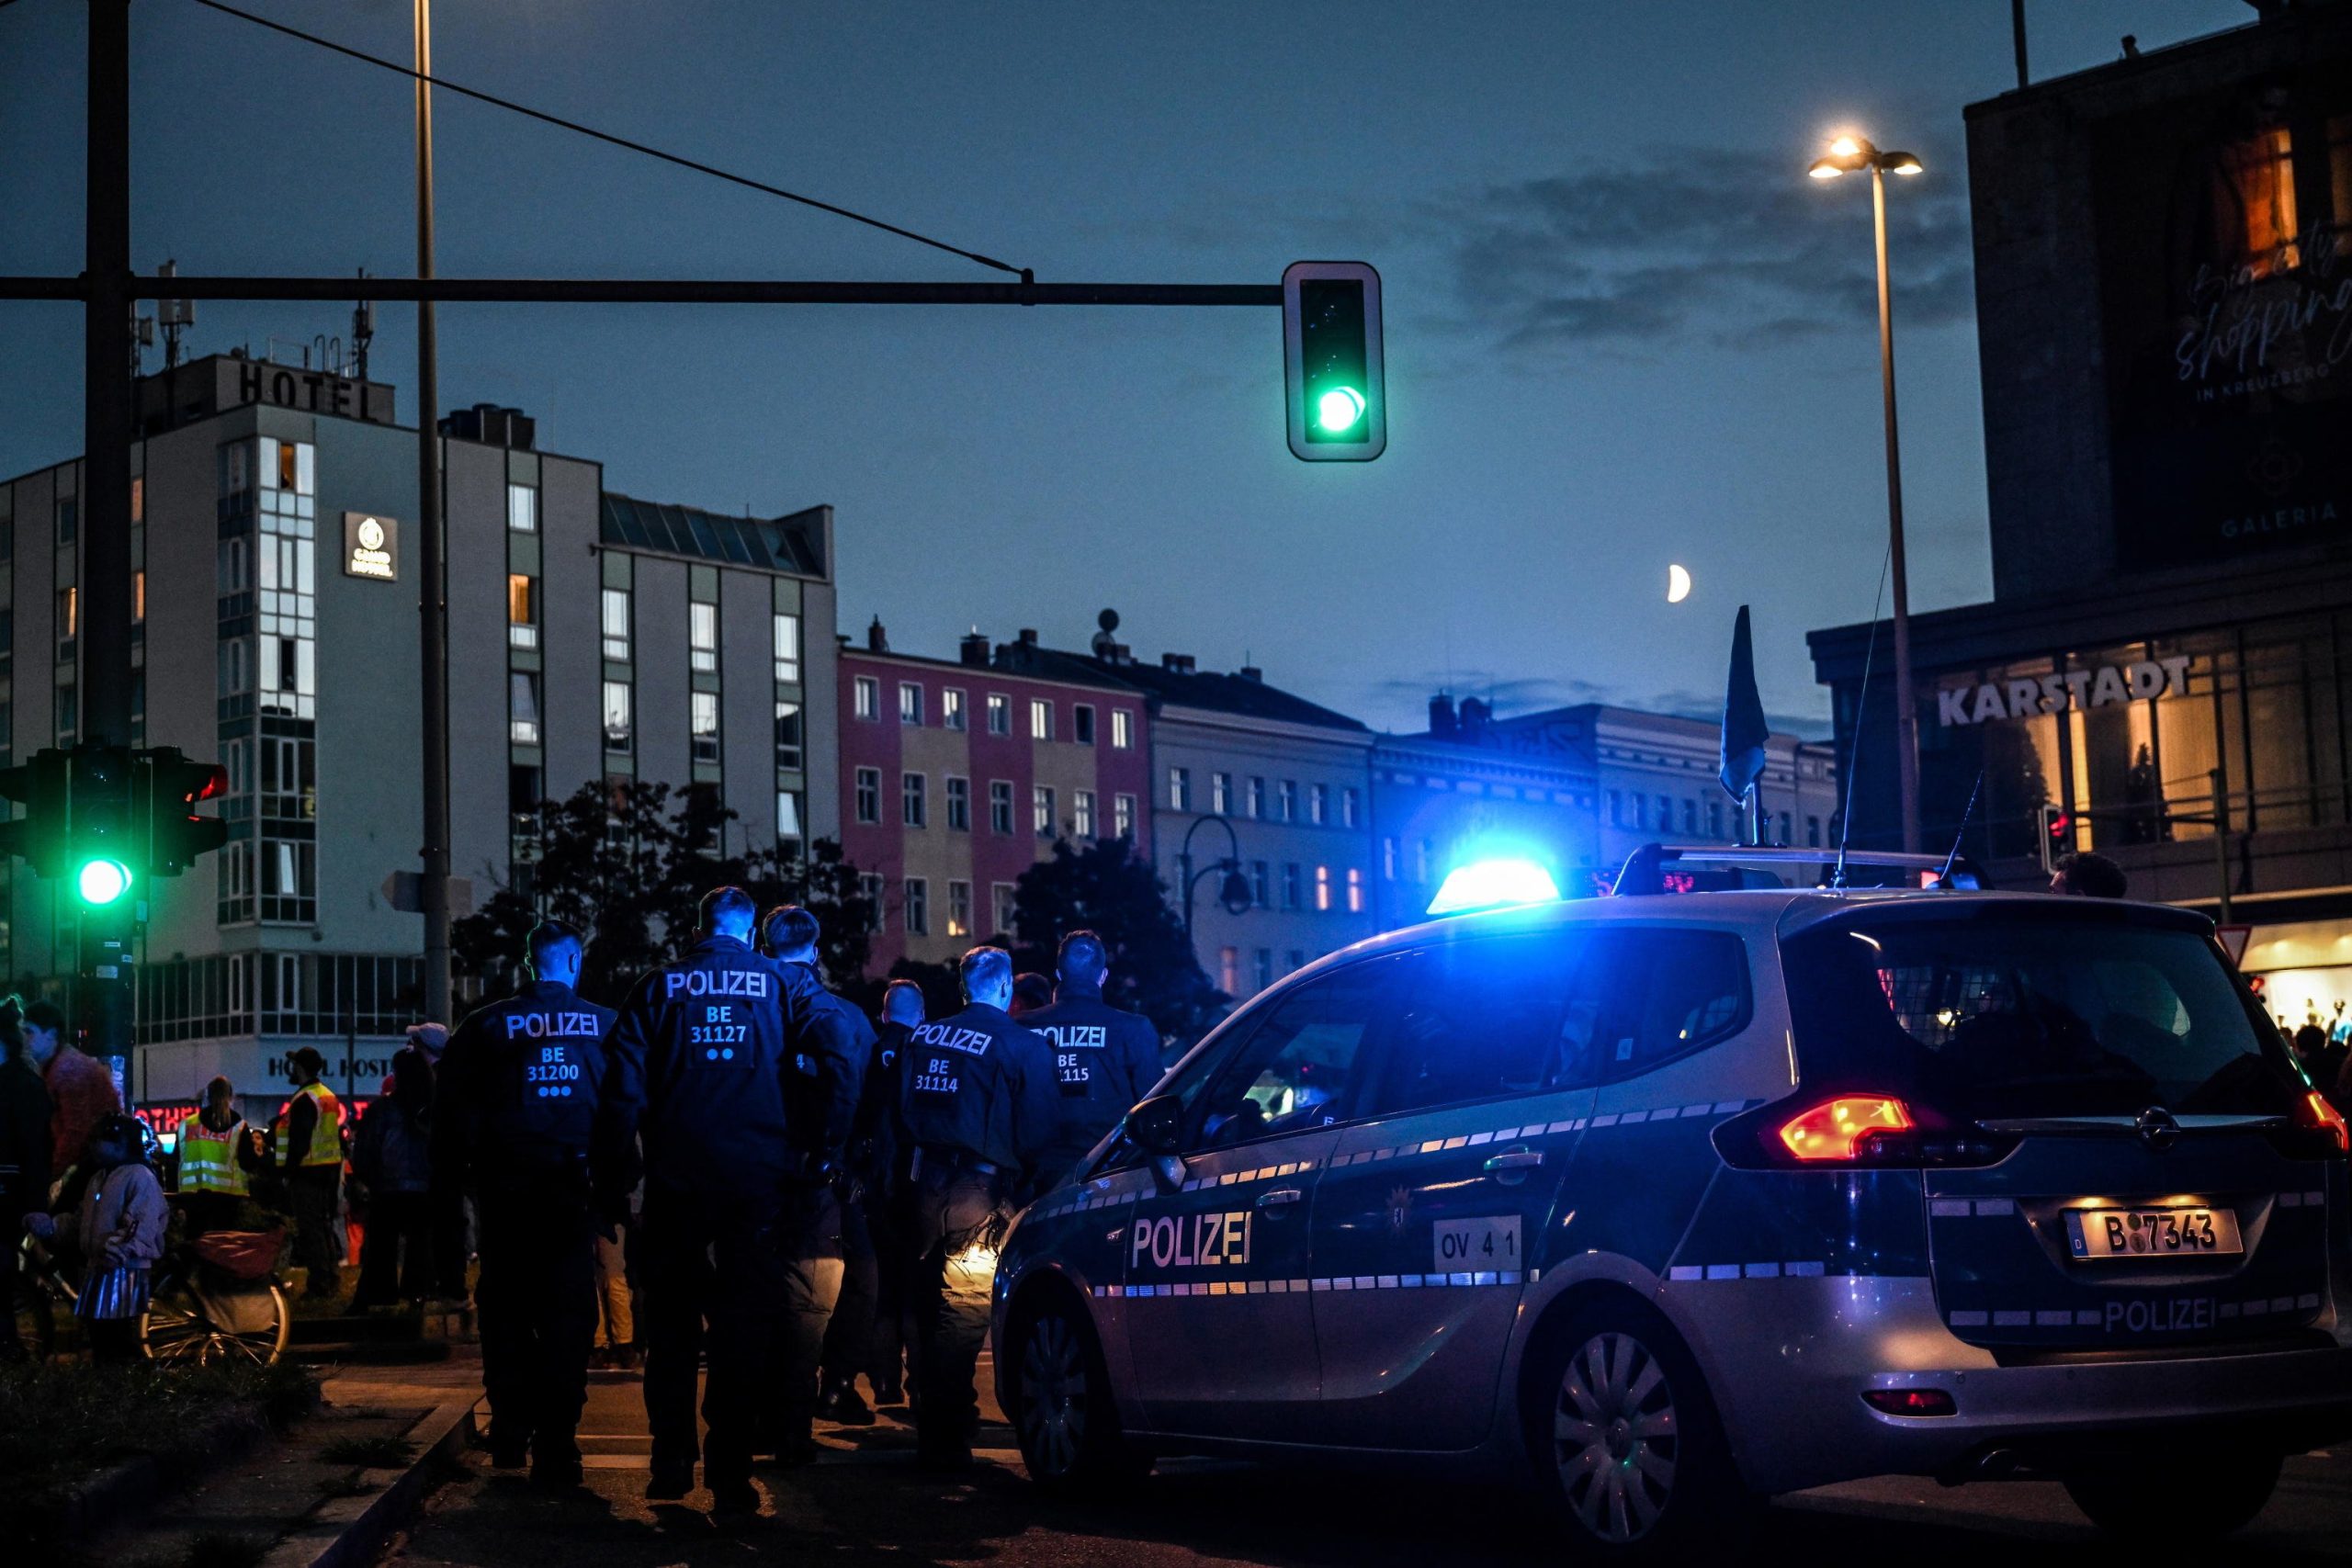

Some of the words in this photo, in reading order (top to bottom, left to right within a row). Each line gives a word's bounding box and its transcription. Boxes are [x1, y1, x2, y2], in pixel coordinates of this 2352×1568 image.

[241, 364, 379, 423] HOTEL
[2222, 363, 2331, 398] KREUZBERG
[2221, 502, 2336, 537] GALERIA
[1938, 655, 2190, 728] KARSTADT
[666, 970, 766, 998] POLIZEI
[506, 1012, 599, 1040] POLIZEI
[707, 1006, 731, 1023] BE
[691, 1025, 746, 1043] 31127
[910, 1023, 992, 1056] POLIZEI
[542, 1047, 565, 1063] BE
[928, 1058, 950, 1076] BE
[1057, 1054, 1077, 1068] BE
[527, 1065, 579, 1082] 31200
[915, 1075, 958, 1094] 31114
[1132, 1211, 1252, 1269] POLIZEI
[1442, 1233, 1469, 1258] OV
[1482, 1231, 1494, 1258] 4
[1505, 1230, 1514, 1256] 1
[2104, 1215, 2127, 1252] B
[2142, 1213, 2217, 1250] 7343
[2105, 1297, 2215, 1333] POLIZEI
